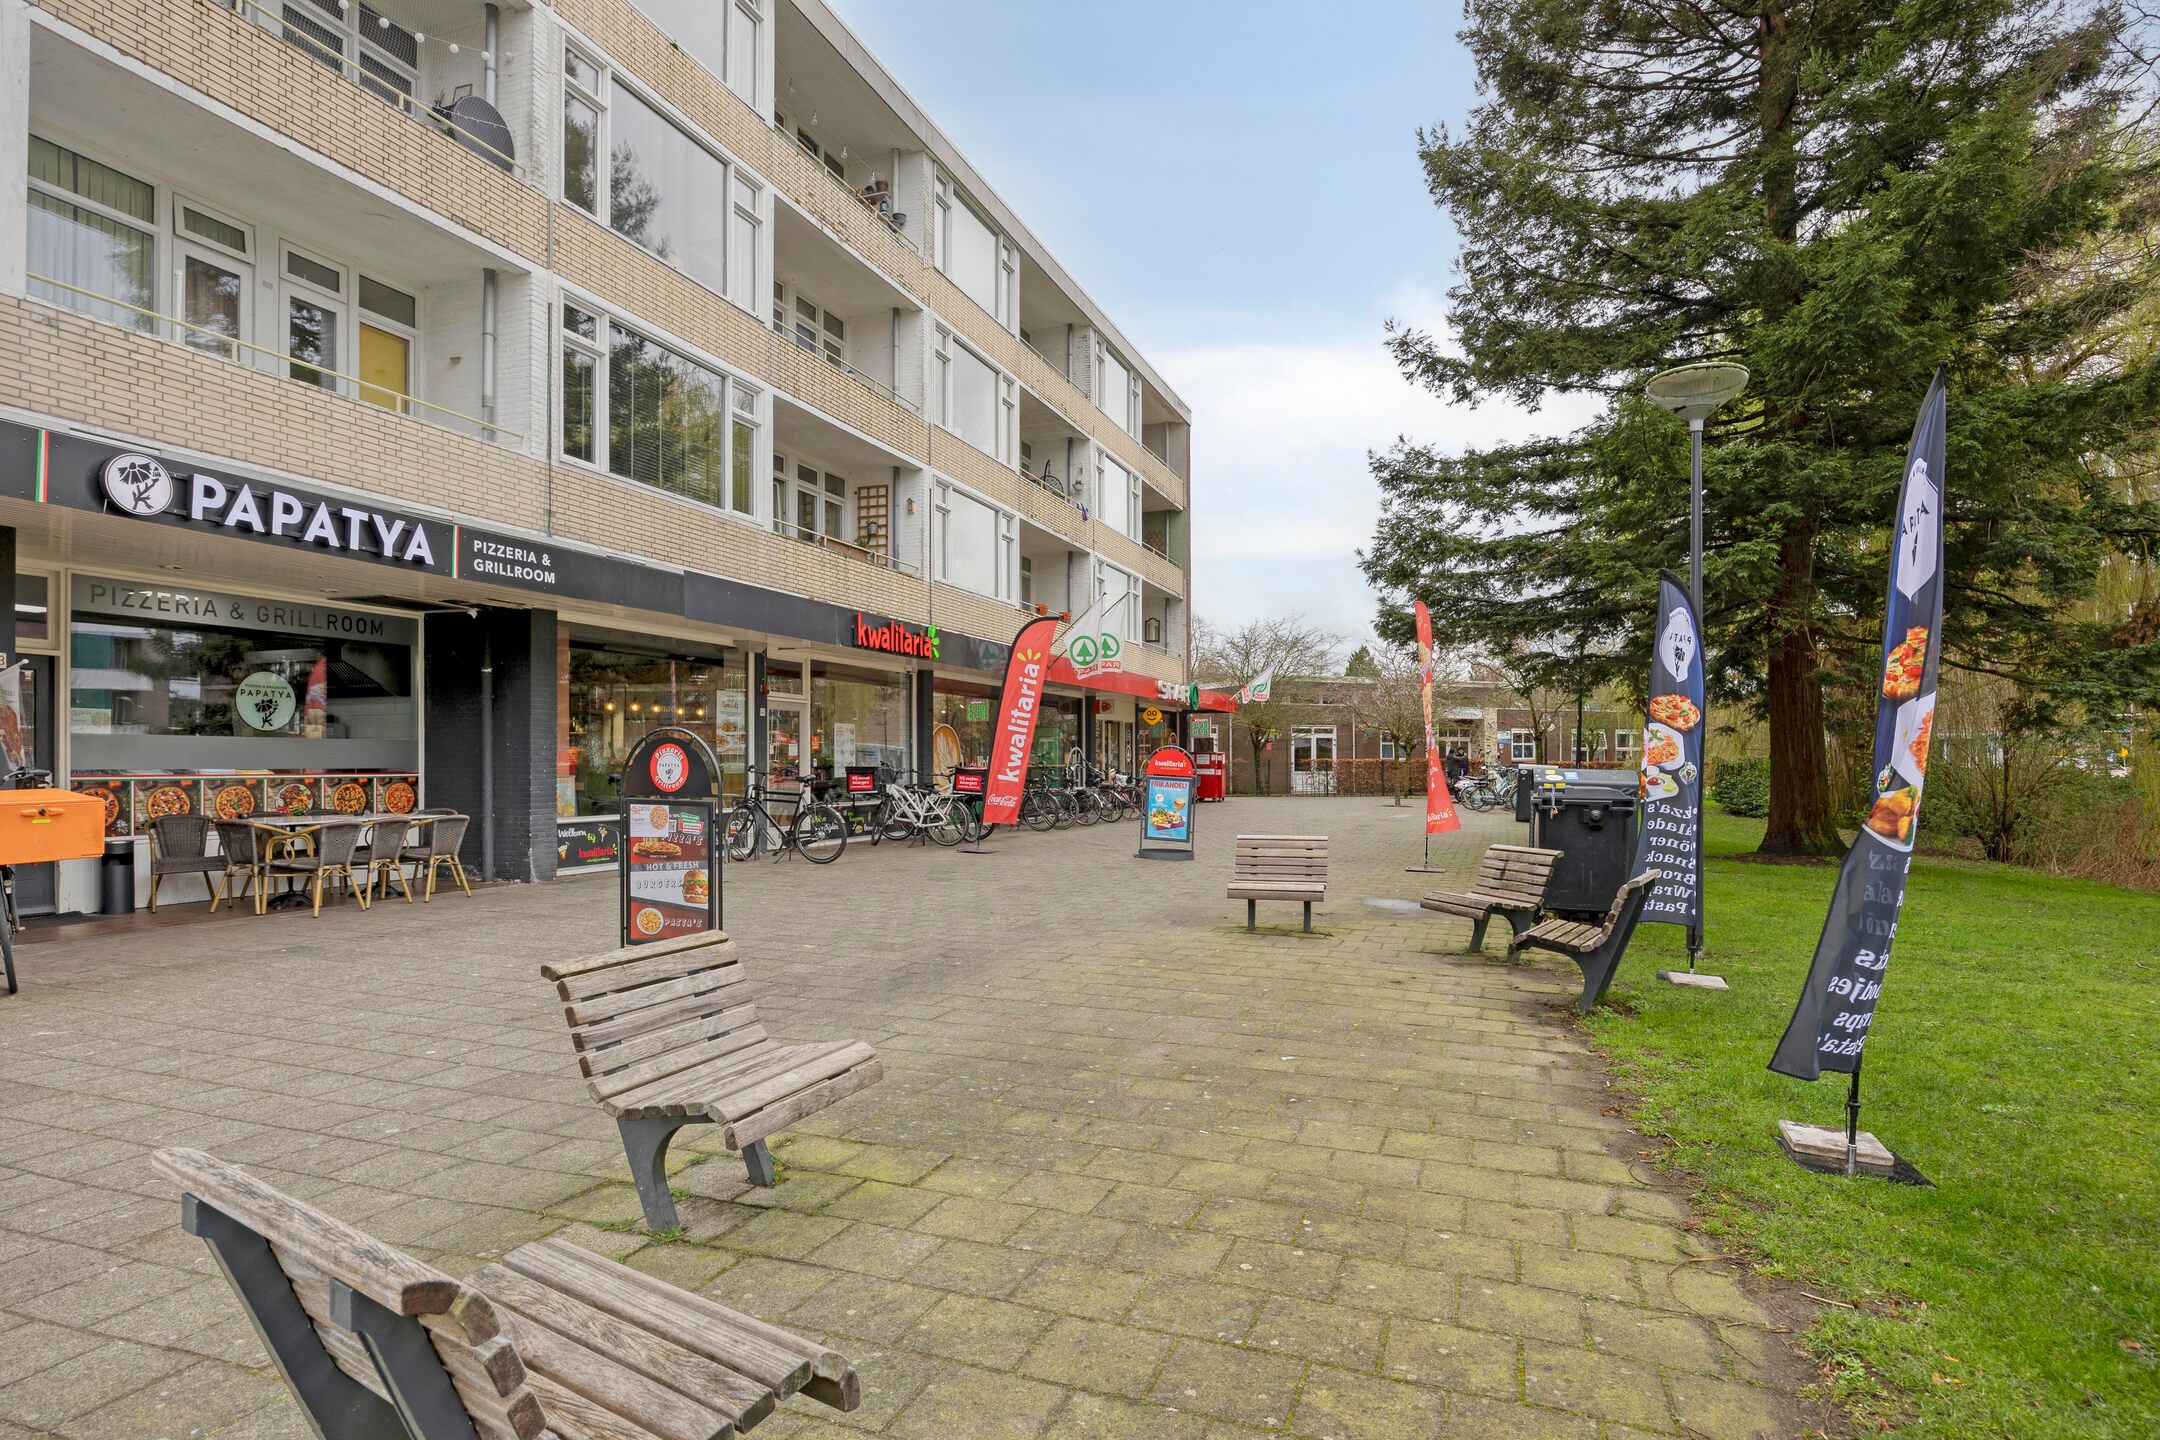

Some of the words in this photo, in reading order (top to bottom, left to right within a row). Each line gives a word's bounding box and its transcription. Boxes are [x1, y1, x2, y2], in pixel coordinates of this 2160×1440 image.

[191, 473, 435, 565] PAPATYA
[473, 539, 537, 564] PIZZERIA
[541, 553, 551, 567] &
[473, 558, 555, 584] GRILLROOM
[90, 583, 218, 618] PIZZERIA
[230, 601, 245, 621] &
[256, 605, 384, 637] GRILLROOM
[857, 611, 932, 659] kwalitaria
[1101, 660, 1120, 669] PAR
[240, 688, 292, 699] PAPATYA
[1157, 680, 1191, 705] SPAR
[997, 662, 1040, 783] kwalitaria
[1154, 760, 1184, 768] kwalitaria
[558, 827, 587, 837] Welkom
[662, 833, 704, 846] IZZA'S
[646, 863, 664, 871] HOT
[673, 861, 699, 870] FRESH
[636, 878, 683, 889] BURGERS
[665, 917, 702, 928] PASTA'S
